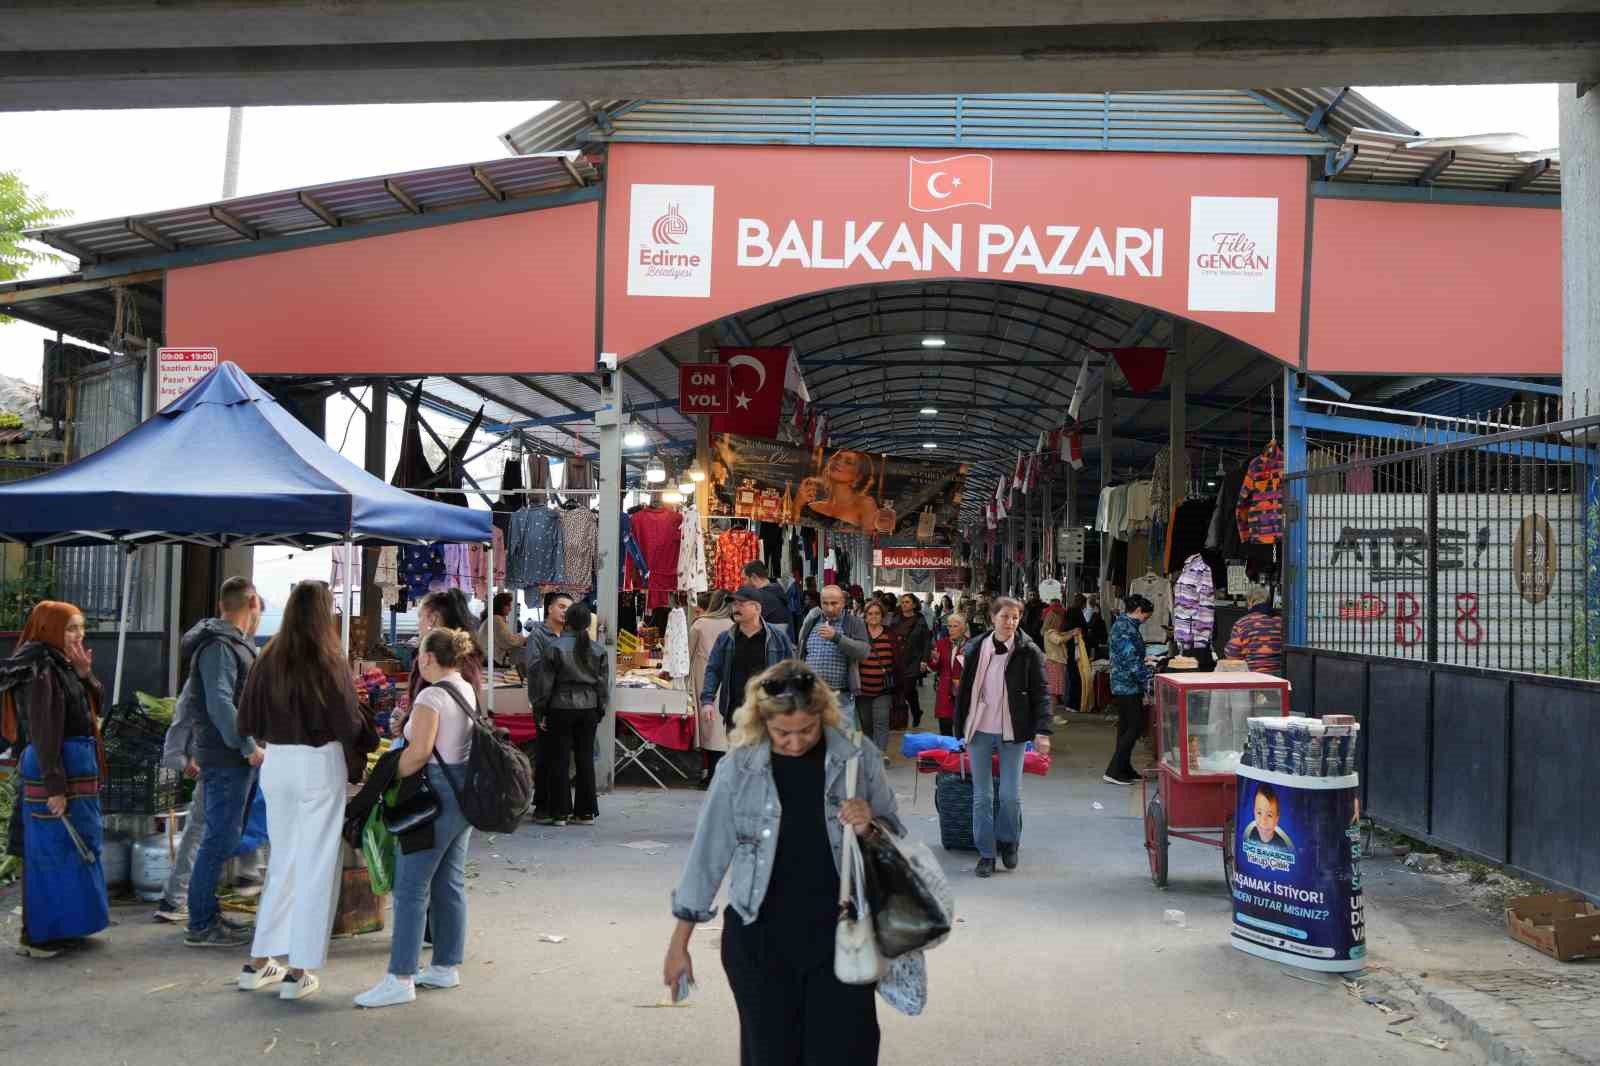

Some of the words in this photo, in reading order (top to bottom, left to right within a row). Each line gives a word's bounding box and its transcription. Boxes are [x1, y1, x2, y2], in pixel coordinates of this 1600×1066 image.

[737, 218, 963, 272] BALKAN
[978, 223, 1164, 277] PAZARI
[1212, 232, 1256, 256] Filiz
[639, 248, 701, 267] Edirne
[1196, 254, 1270, 270] GENCAN
[691, 371, 716, 385] ÖN
[688, 394, 721, 407] YOL
[884, 556, 920, 566] BALKAN
[921, 556, 952, 566] PAZARI
[1273, 880, 1325, 904] İSTİYOR!
[1252, 895, 1283, 913] TUTAR
[1283, 903, 1330, 921] MISINIZ?
